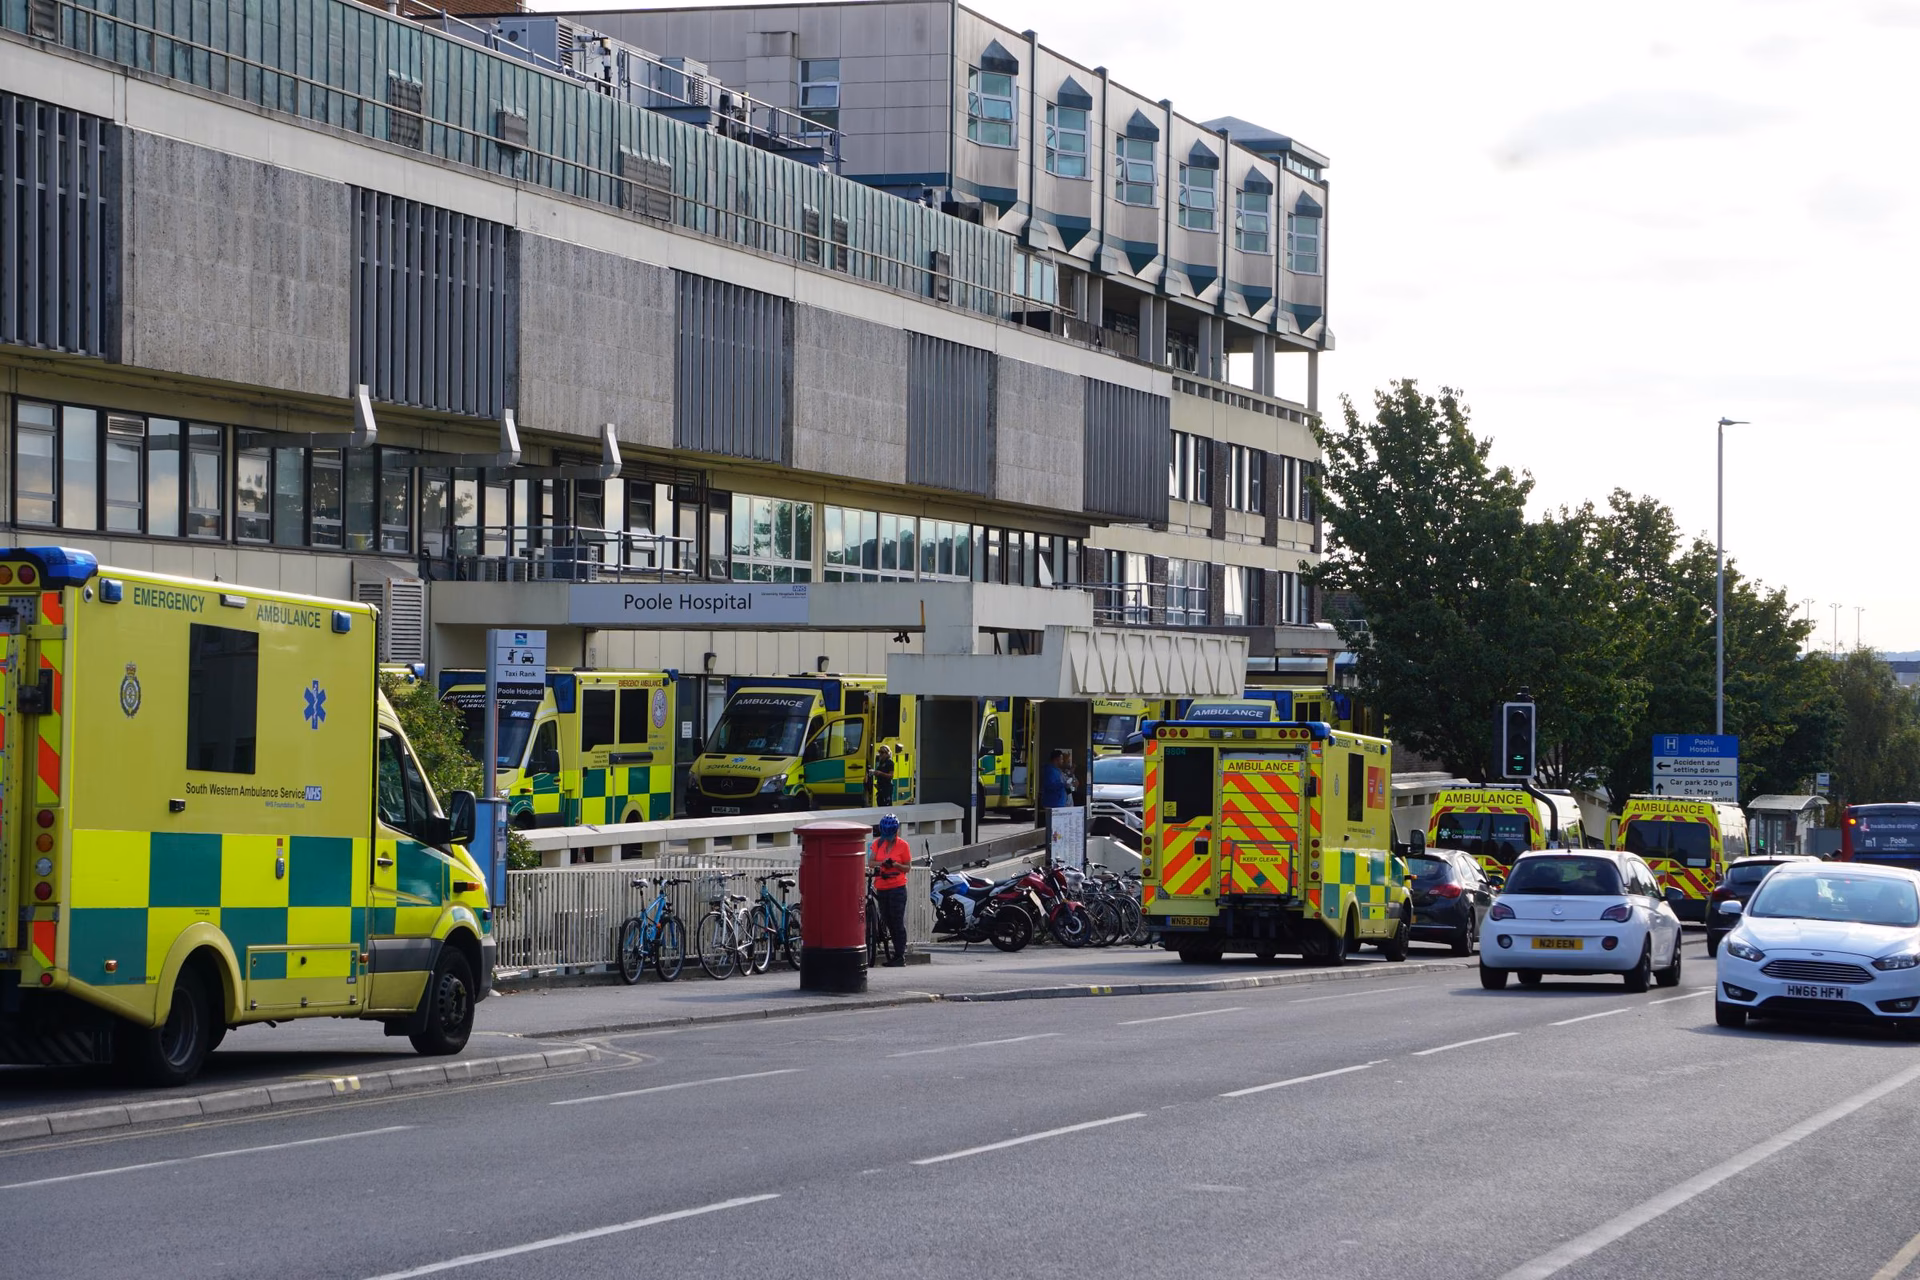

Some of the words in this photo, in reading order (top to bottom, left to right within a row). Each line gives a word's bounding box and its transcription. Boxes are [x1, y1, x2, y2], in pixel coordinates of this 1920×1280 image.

[133, 586, 205, 613] EMERGENCY
[256, 604, 321, 628] AMBULANCE
[624, 594, 673, 610] Poole
[680, 593, 752, 614] Hospital
[517, 687, 543, 695] Hospital
[736, 698, 803, 708] AMBULANCE
[1095, 700, 1132, 708] ULANCE
[1193, 708, 1264, 718] AMBULANCE
[1690, 746, 1719, 754] Hospital
[1228, 762, 1294, 771] AMBULANCE
[1684, 779, 1701, 787] park
[185, 782, 208, 795] South
[209, 783, 238, 795] Western
[240, 786, 278, 797] Ambulance
[280, 787, 305, 799] Service
[305, 786, 321, 800] NHS
[1444, 793, 1523, 805] AMBULANCE
[1633, 802, 1704, 814] AMBULANCE
[1865, 837, 1876, 847] m1
[1171, 917, 1192, 925] WN63
[1787, 985, 1818, 997] HW66
